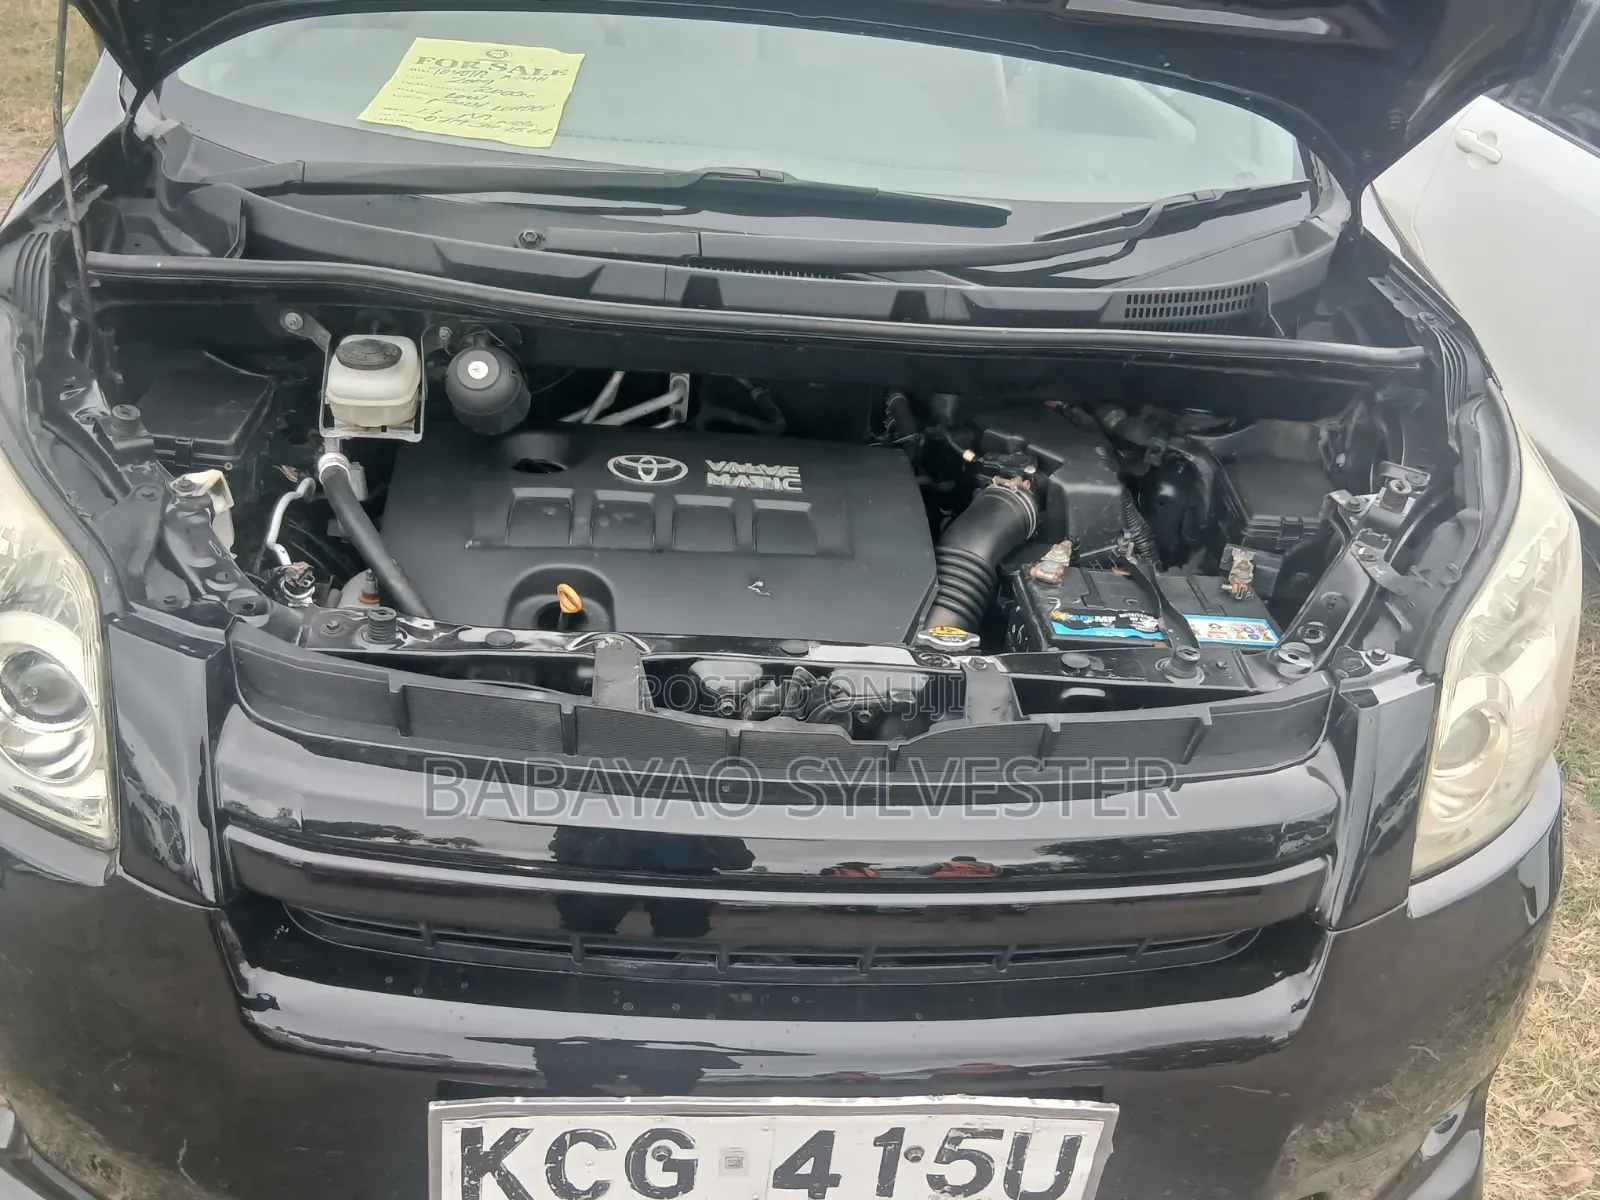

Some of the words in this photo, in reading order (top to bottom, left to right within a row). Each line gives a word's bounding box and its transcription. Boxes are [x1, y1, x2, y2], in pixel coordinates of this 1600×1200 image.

[414, 55, 481, 70] FOR
[489, 61, 569, 77] SALE
[704, 459, 801, 477] VALVE
[706, 472, 803, 491] MATIC
[460, 1127, 699, 1200] KCG
[772, 1126, 1082, 1200] 415U
